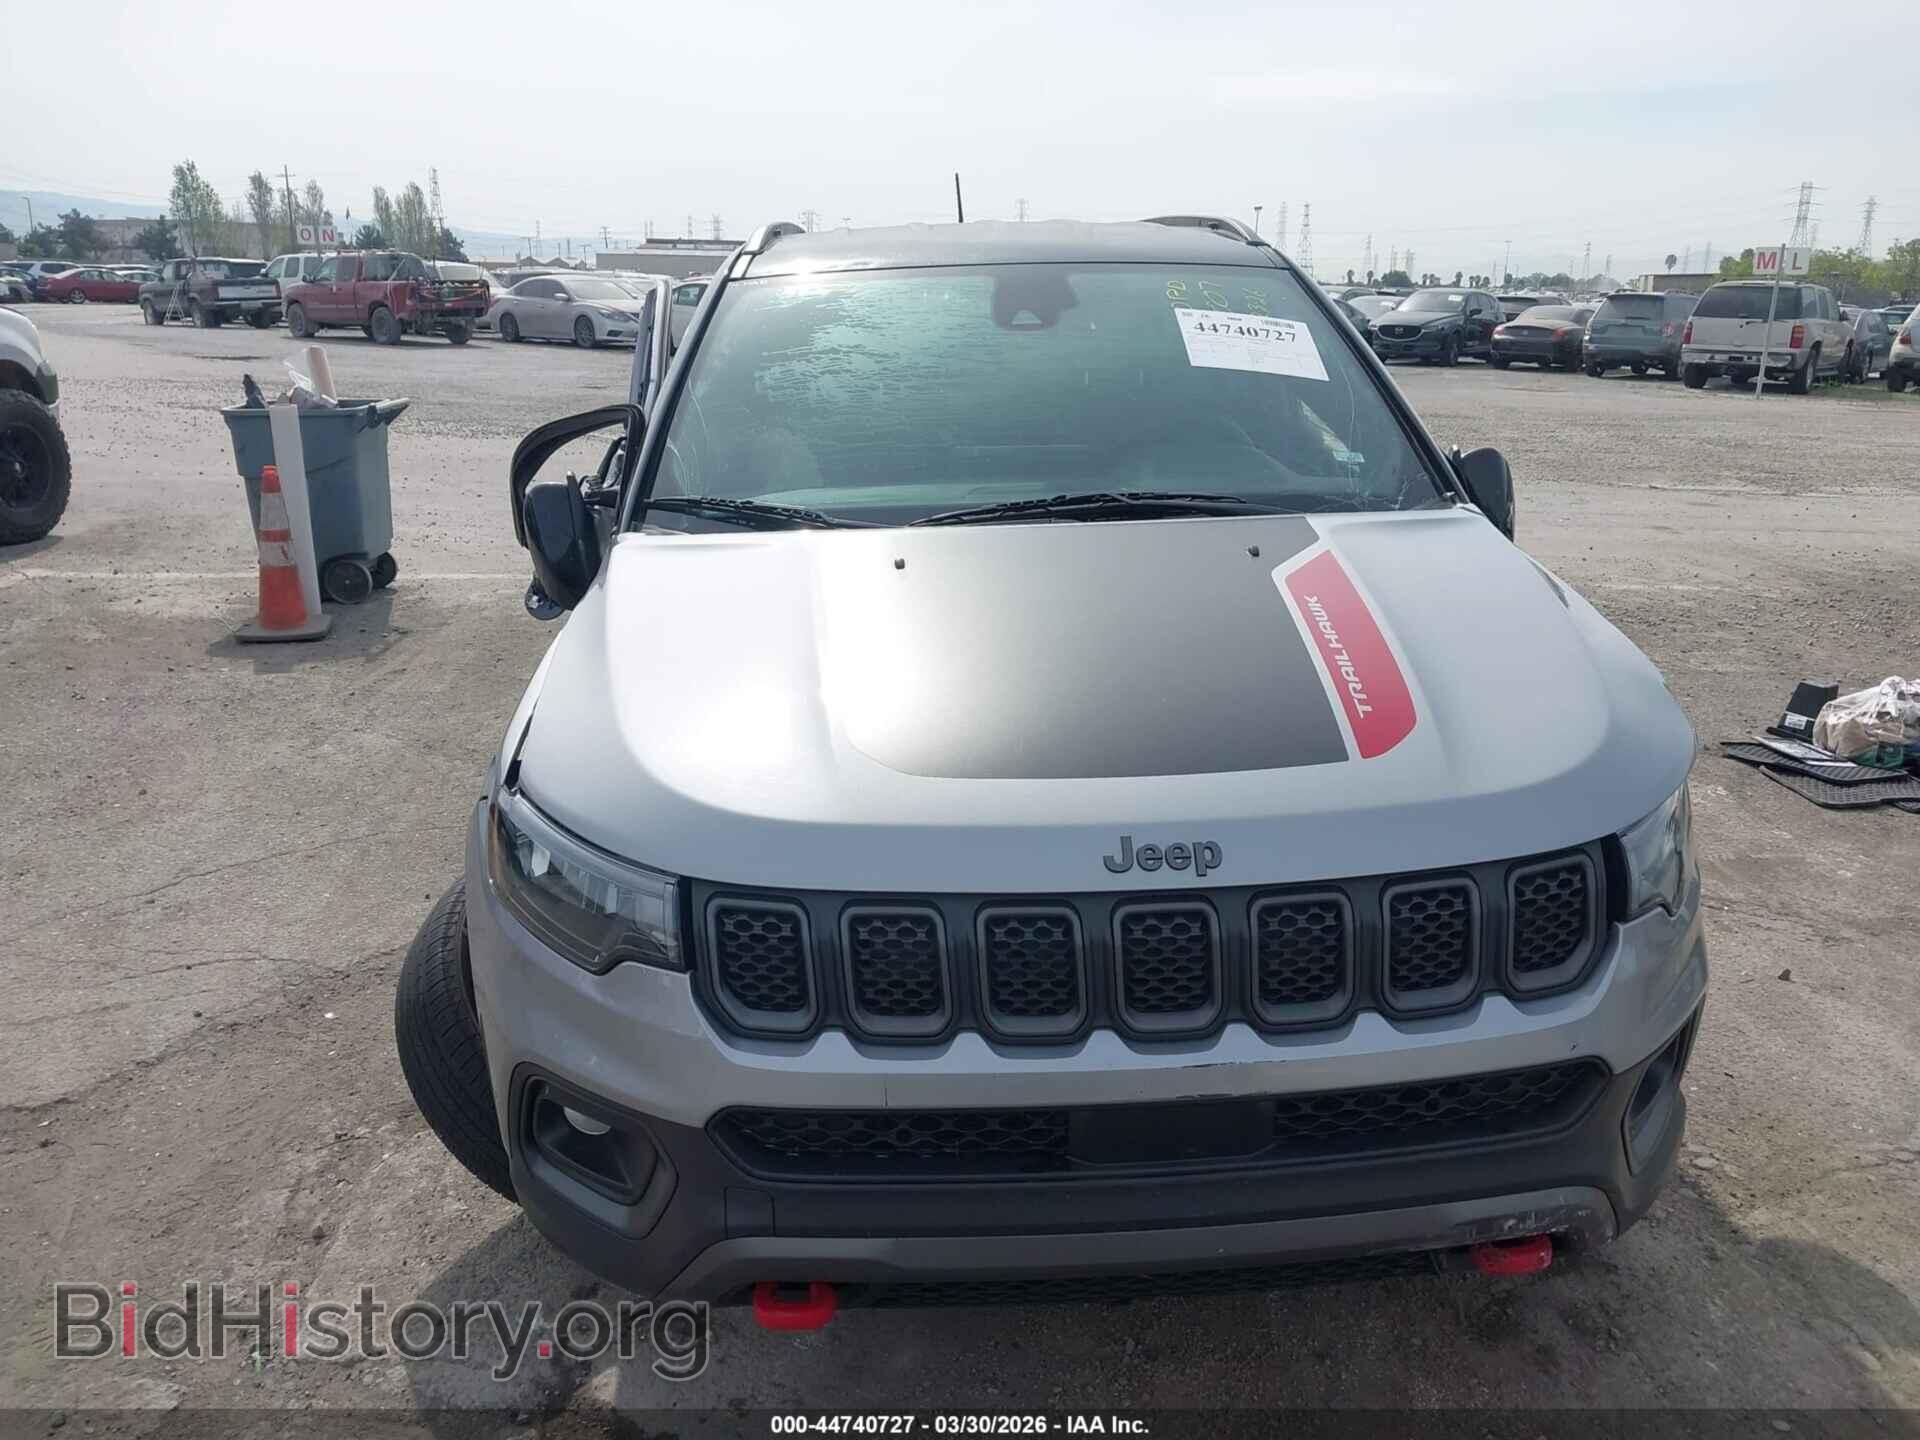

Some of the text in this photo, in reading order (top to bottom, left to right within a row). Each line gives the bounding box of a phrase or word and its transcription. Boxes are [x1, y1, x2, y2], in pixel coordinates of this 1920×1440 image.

[323, 229, 335, 242] N
[1756, 251, 1777, 270] M
[1792, 252, 1803, 270] L
[1194, 321, 1296, 343] 44740727
[1304, 595, 1373, 719] TRAILHAWK
[1103, 835, 1223, 877] Jeep
